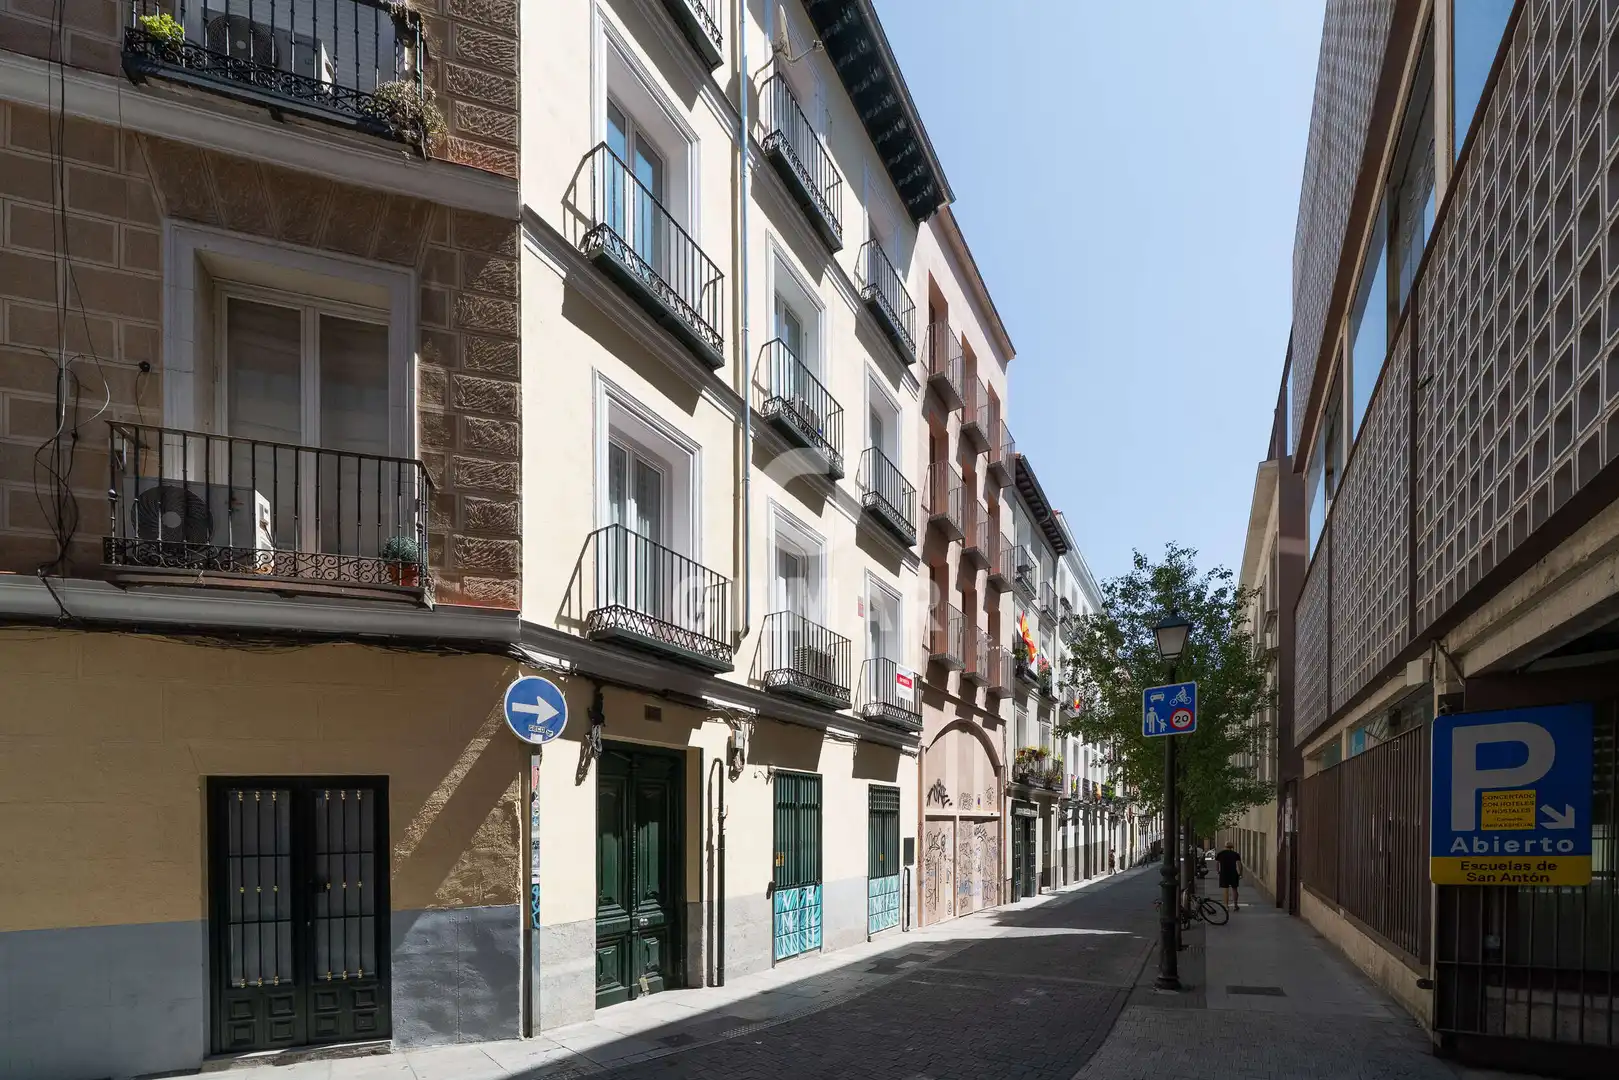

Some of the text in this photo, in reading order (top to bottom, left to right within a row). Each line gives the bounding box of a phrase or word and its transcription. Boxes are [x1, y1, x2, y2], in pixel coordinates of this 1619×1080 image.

[1175, 715, 1188, 723] 20
[1451, 721, 1556, 832] P
[1450, 836, 1575, 854] Abierto
[1460, 860, 1558, 871] Escuelas de
[1466, 871, 1551, 883] San Antón
